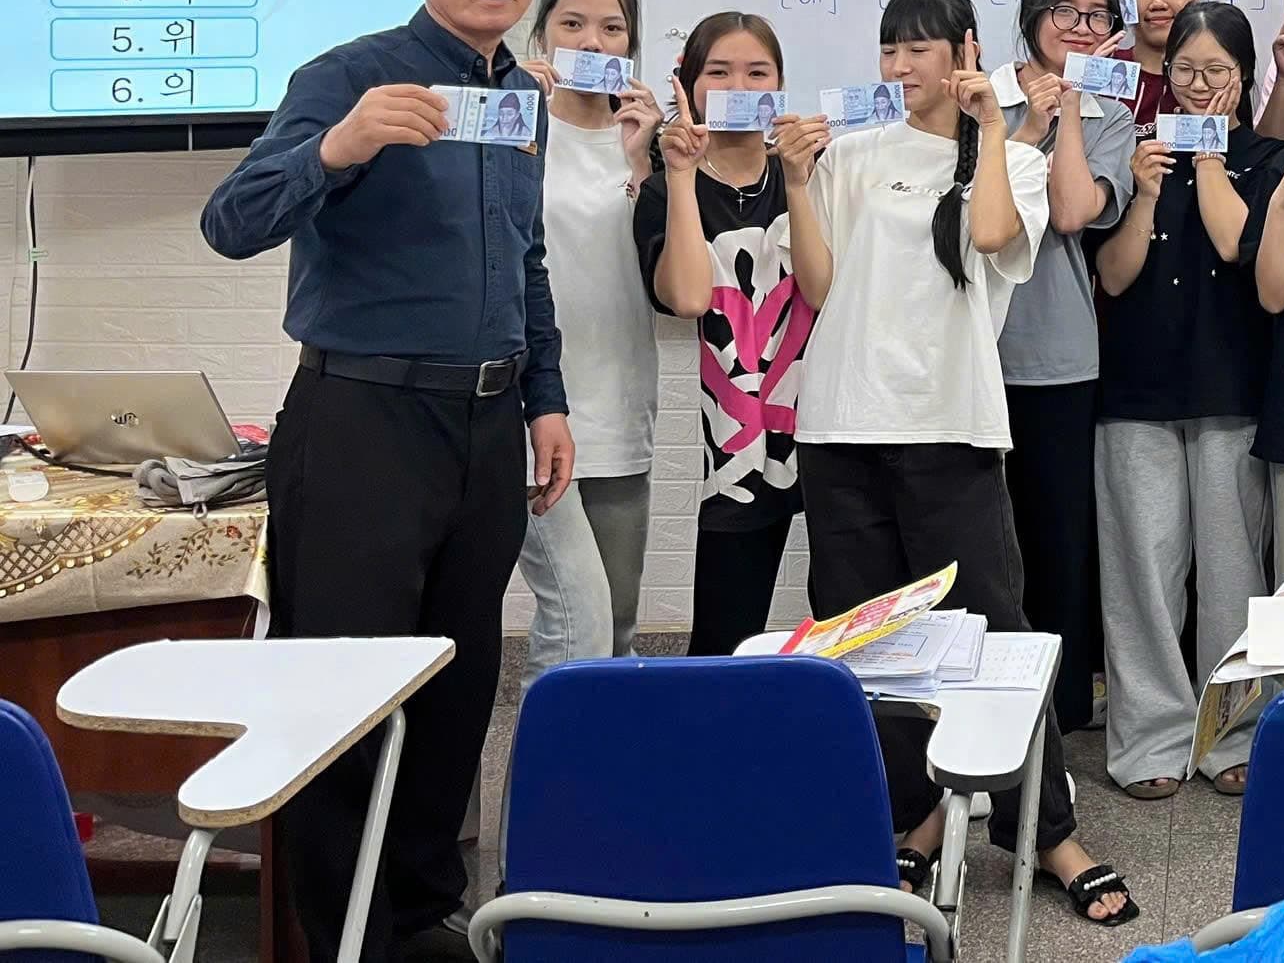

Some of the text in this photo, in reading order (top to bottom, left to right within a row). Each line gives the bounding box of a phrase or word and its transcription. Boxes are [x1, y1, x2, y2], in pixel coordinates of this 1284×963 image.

[112, 19, 195, 56] 5. 위
[111, 69, 195, 105] 6. 의
